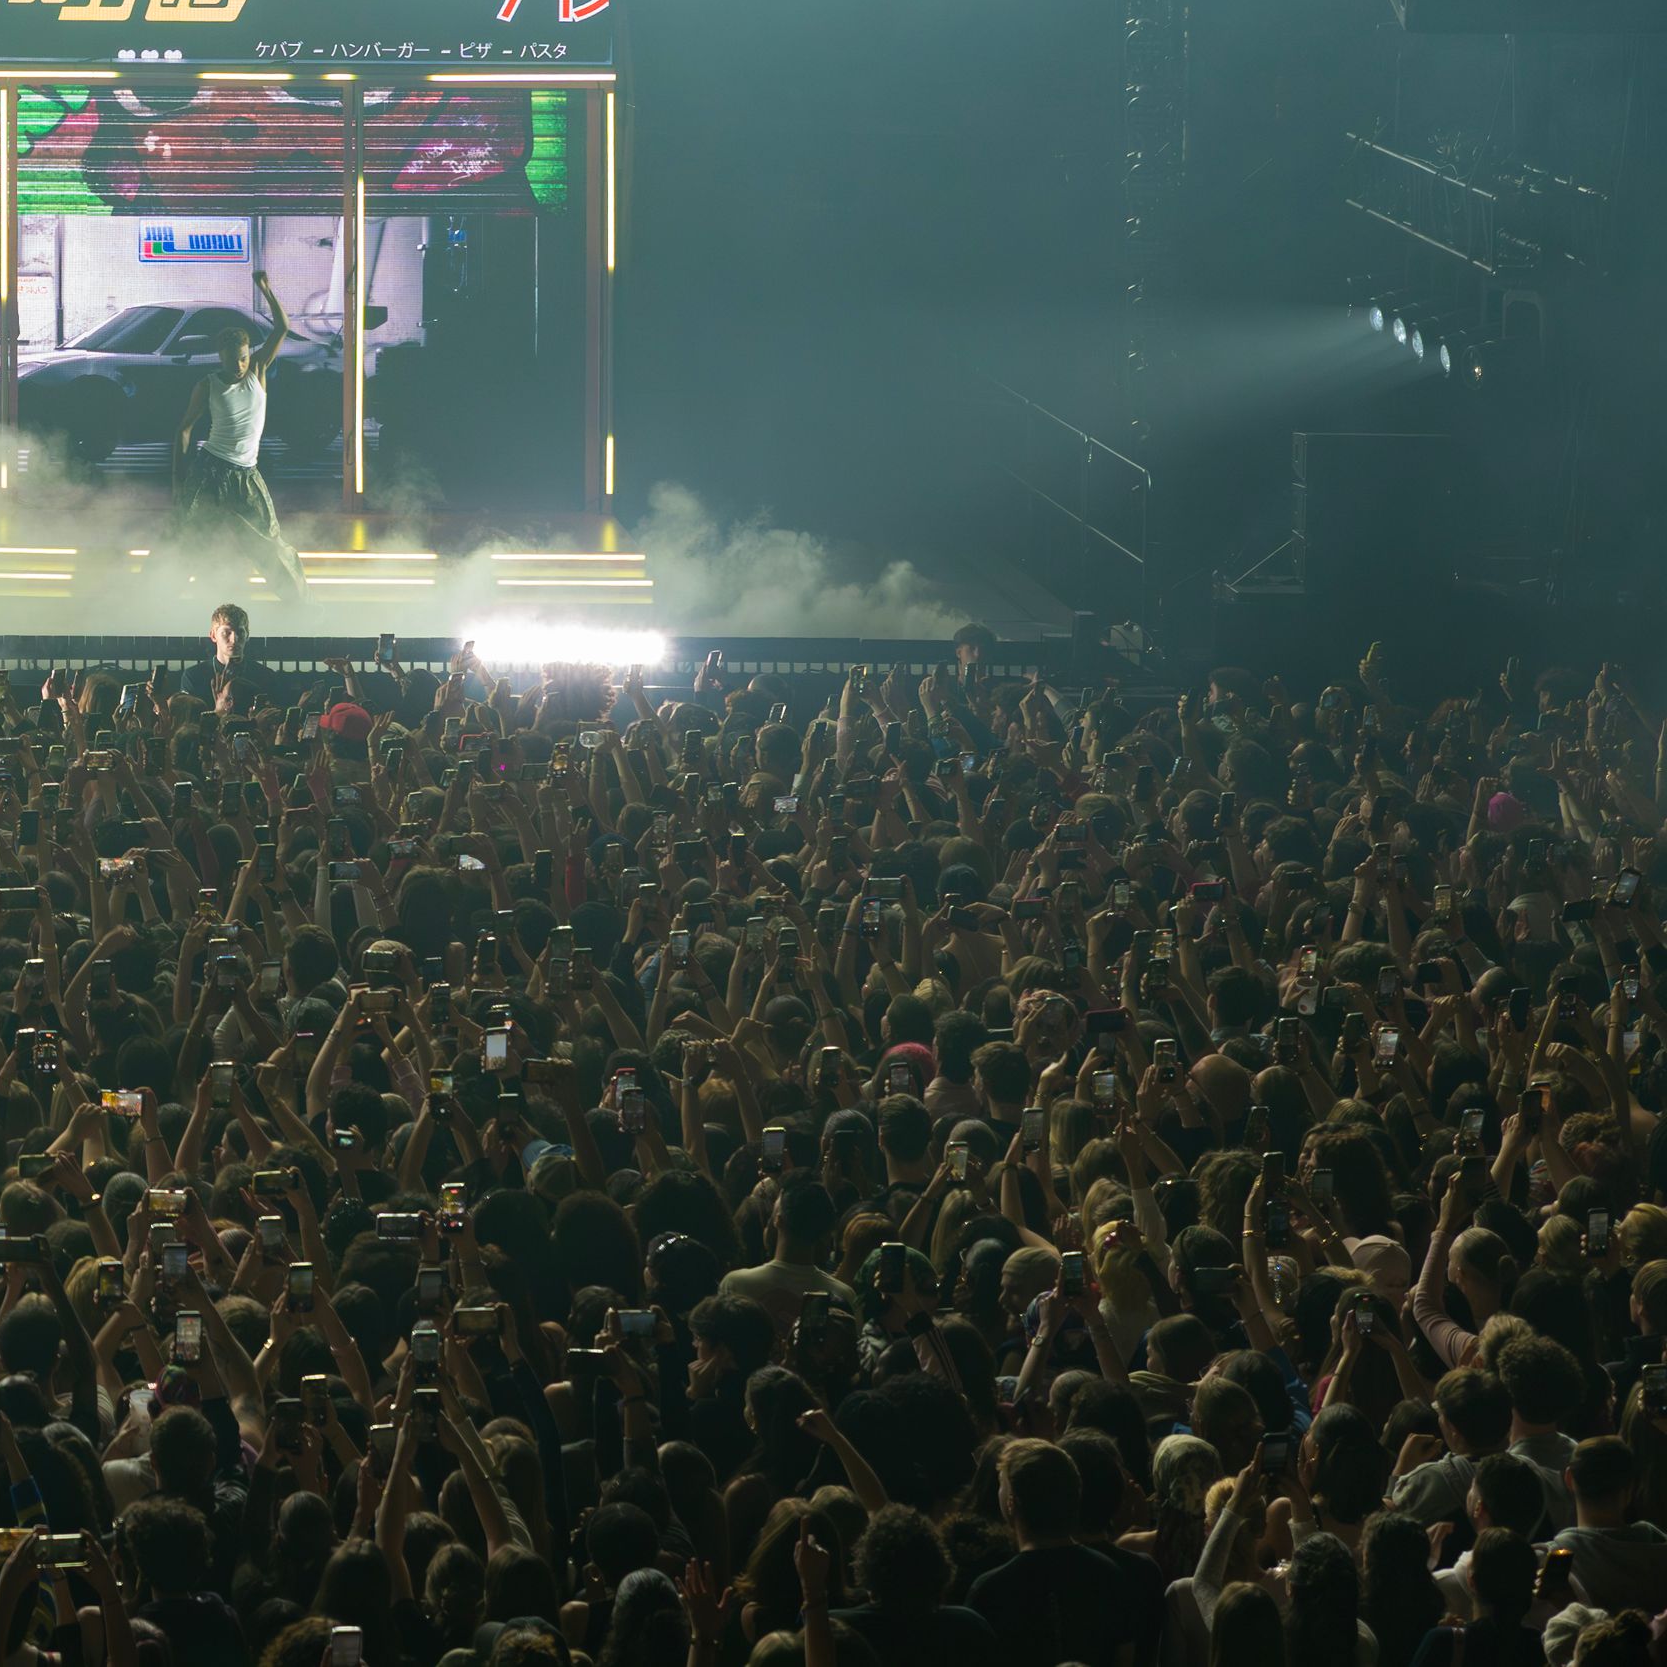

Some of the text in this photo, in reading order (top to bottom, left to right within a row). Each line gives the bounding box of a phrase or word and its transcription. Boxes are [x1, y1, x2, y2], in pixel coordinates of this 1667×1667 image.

[256, 41, 303, 57] ケバブ
[331, 42, 429, 58] ハンバーガー
[461, 42, 492, 58] ピザ
[521, 43, 566, 58] パスタ
